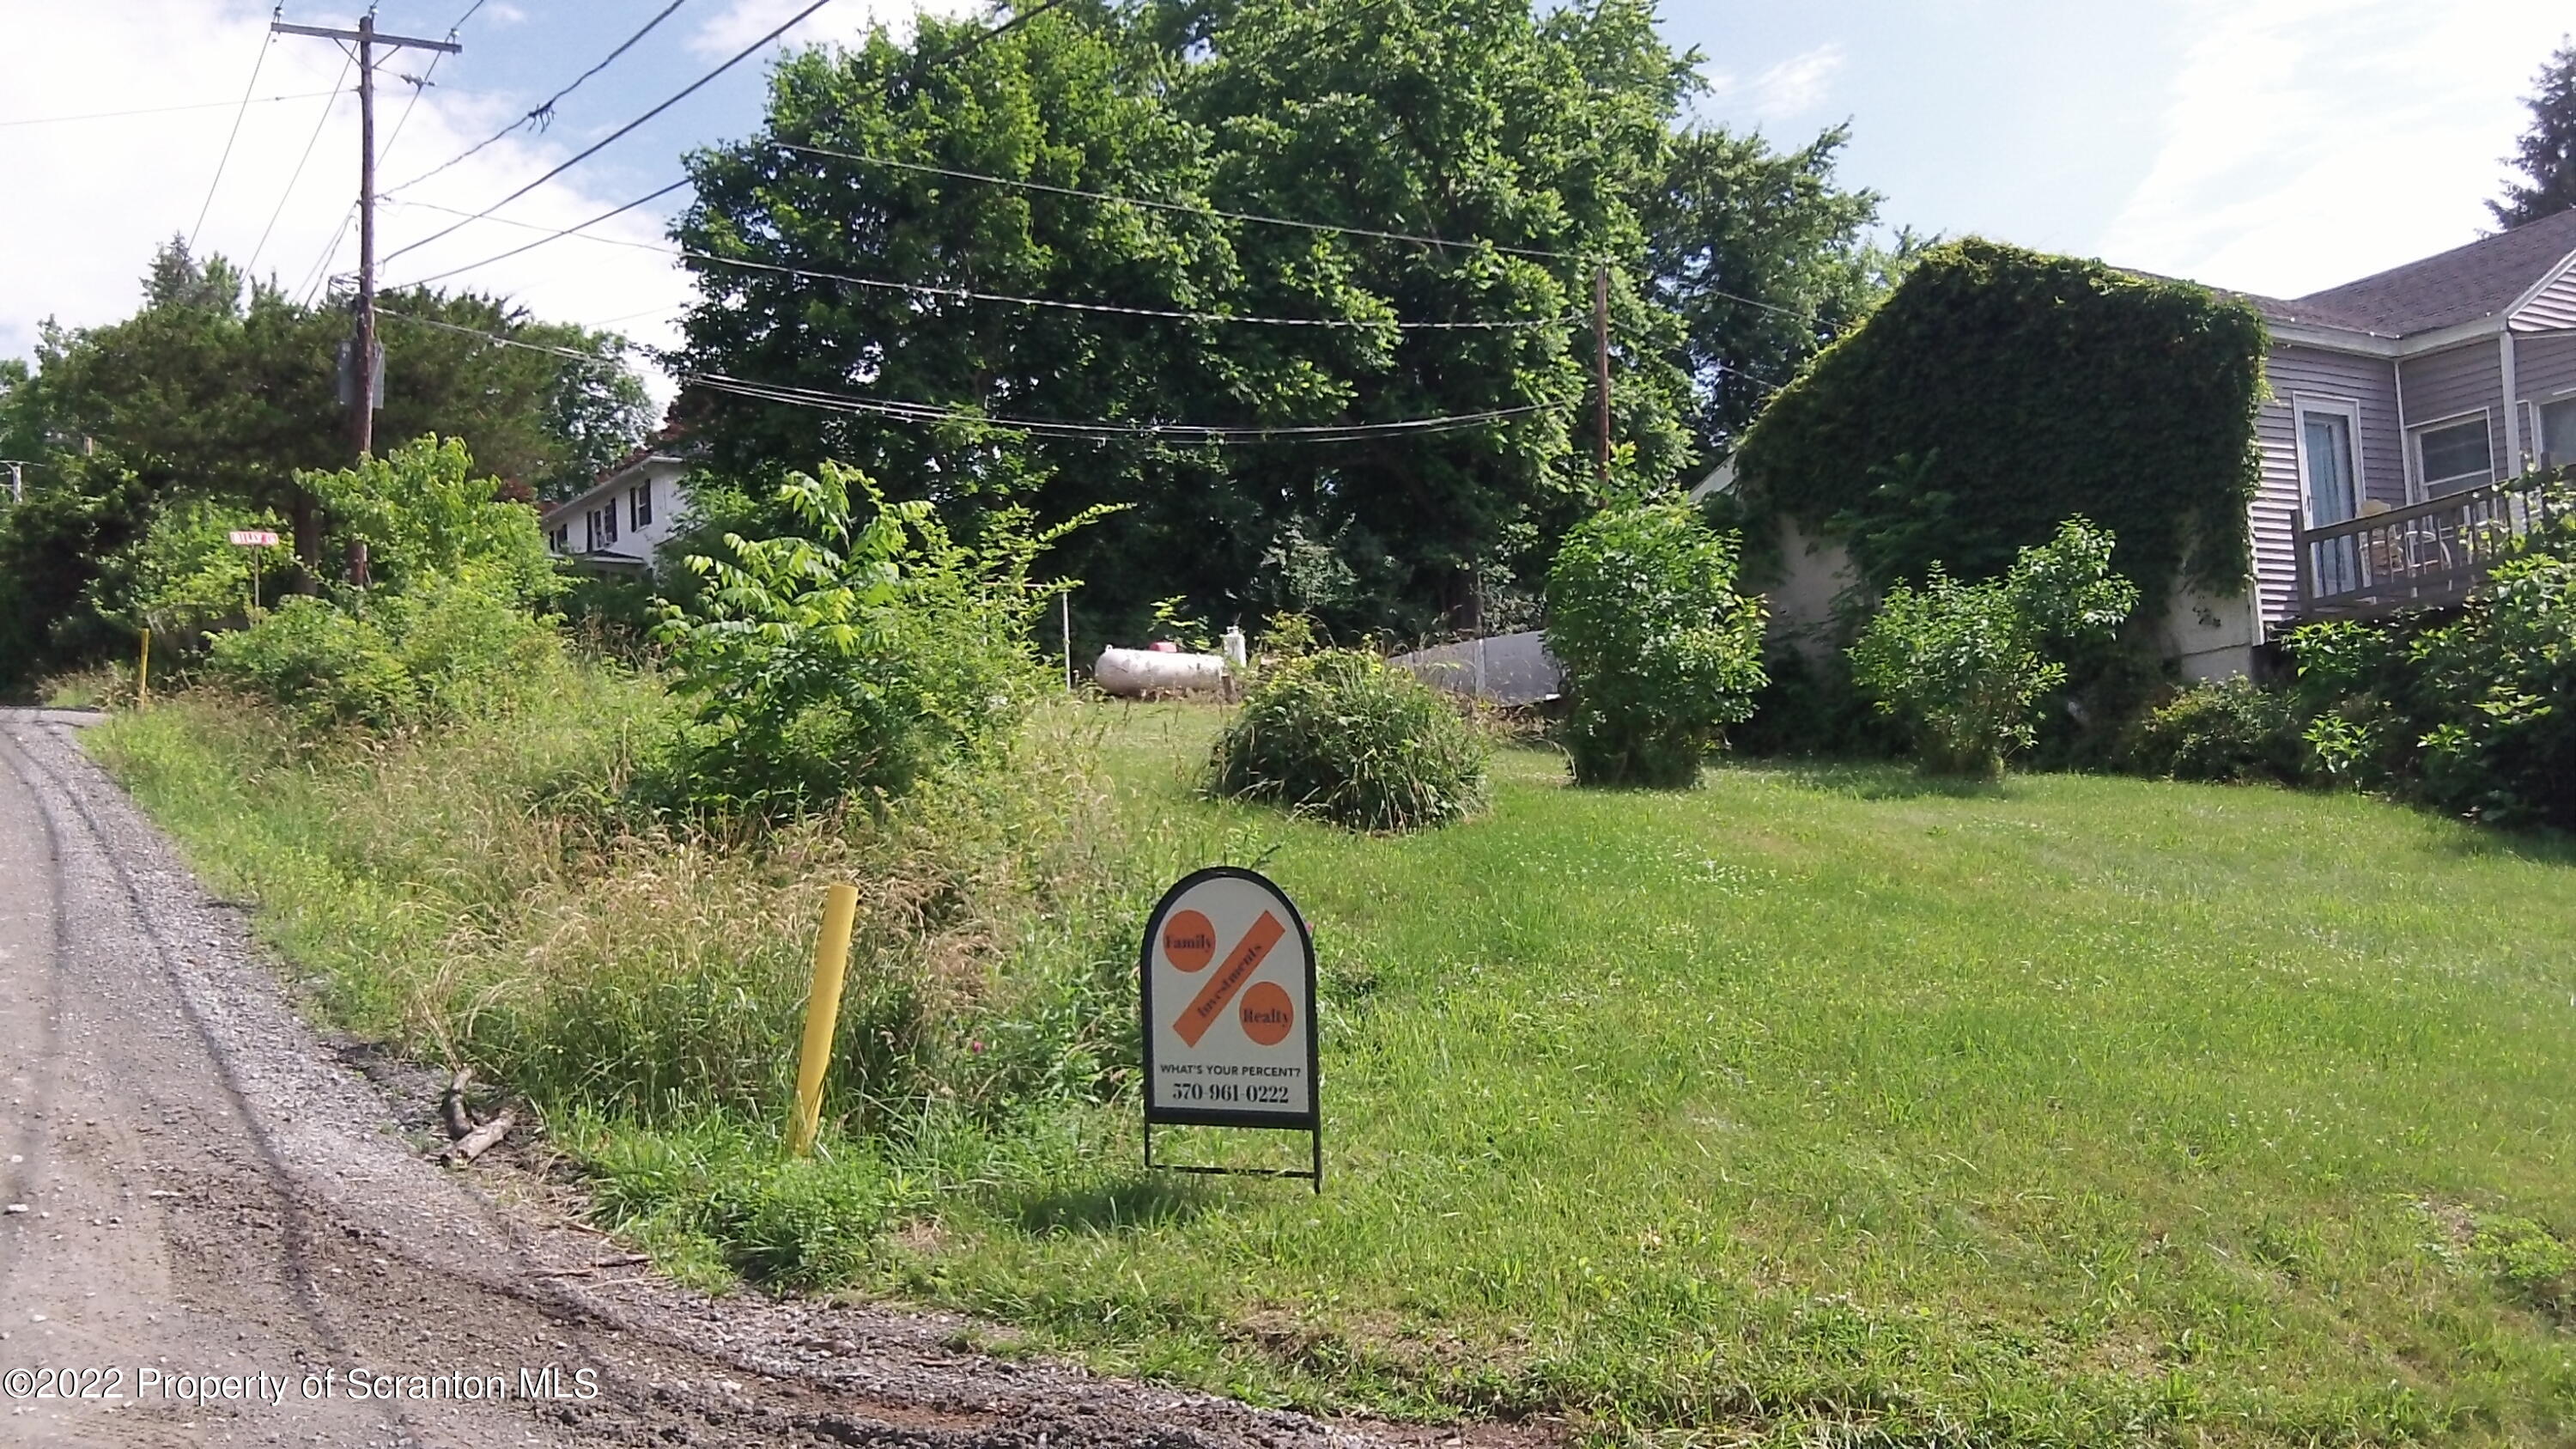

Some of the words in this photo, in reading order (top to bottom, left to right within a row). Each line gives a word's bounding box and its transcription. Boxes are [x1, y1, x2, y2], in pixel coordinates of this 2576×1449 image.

[1165, 934, 1212, 953] Family
[1197, 946, 1262, 1018] Investments
[1243, 1008, 1289, 1028] Realty
[1160, 1064, 1203, 1075] WHAT'S
[1206, 1065, 1238, 1075] YOUR
[1242, 1066, 1301, 1077] PERCENT?
